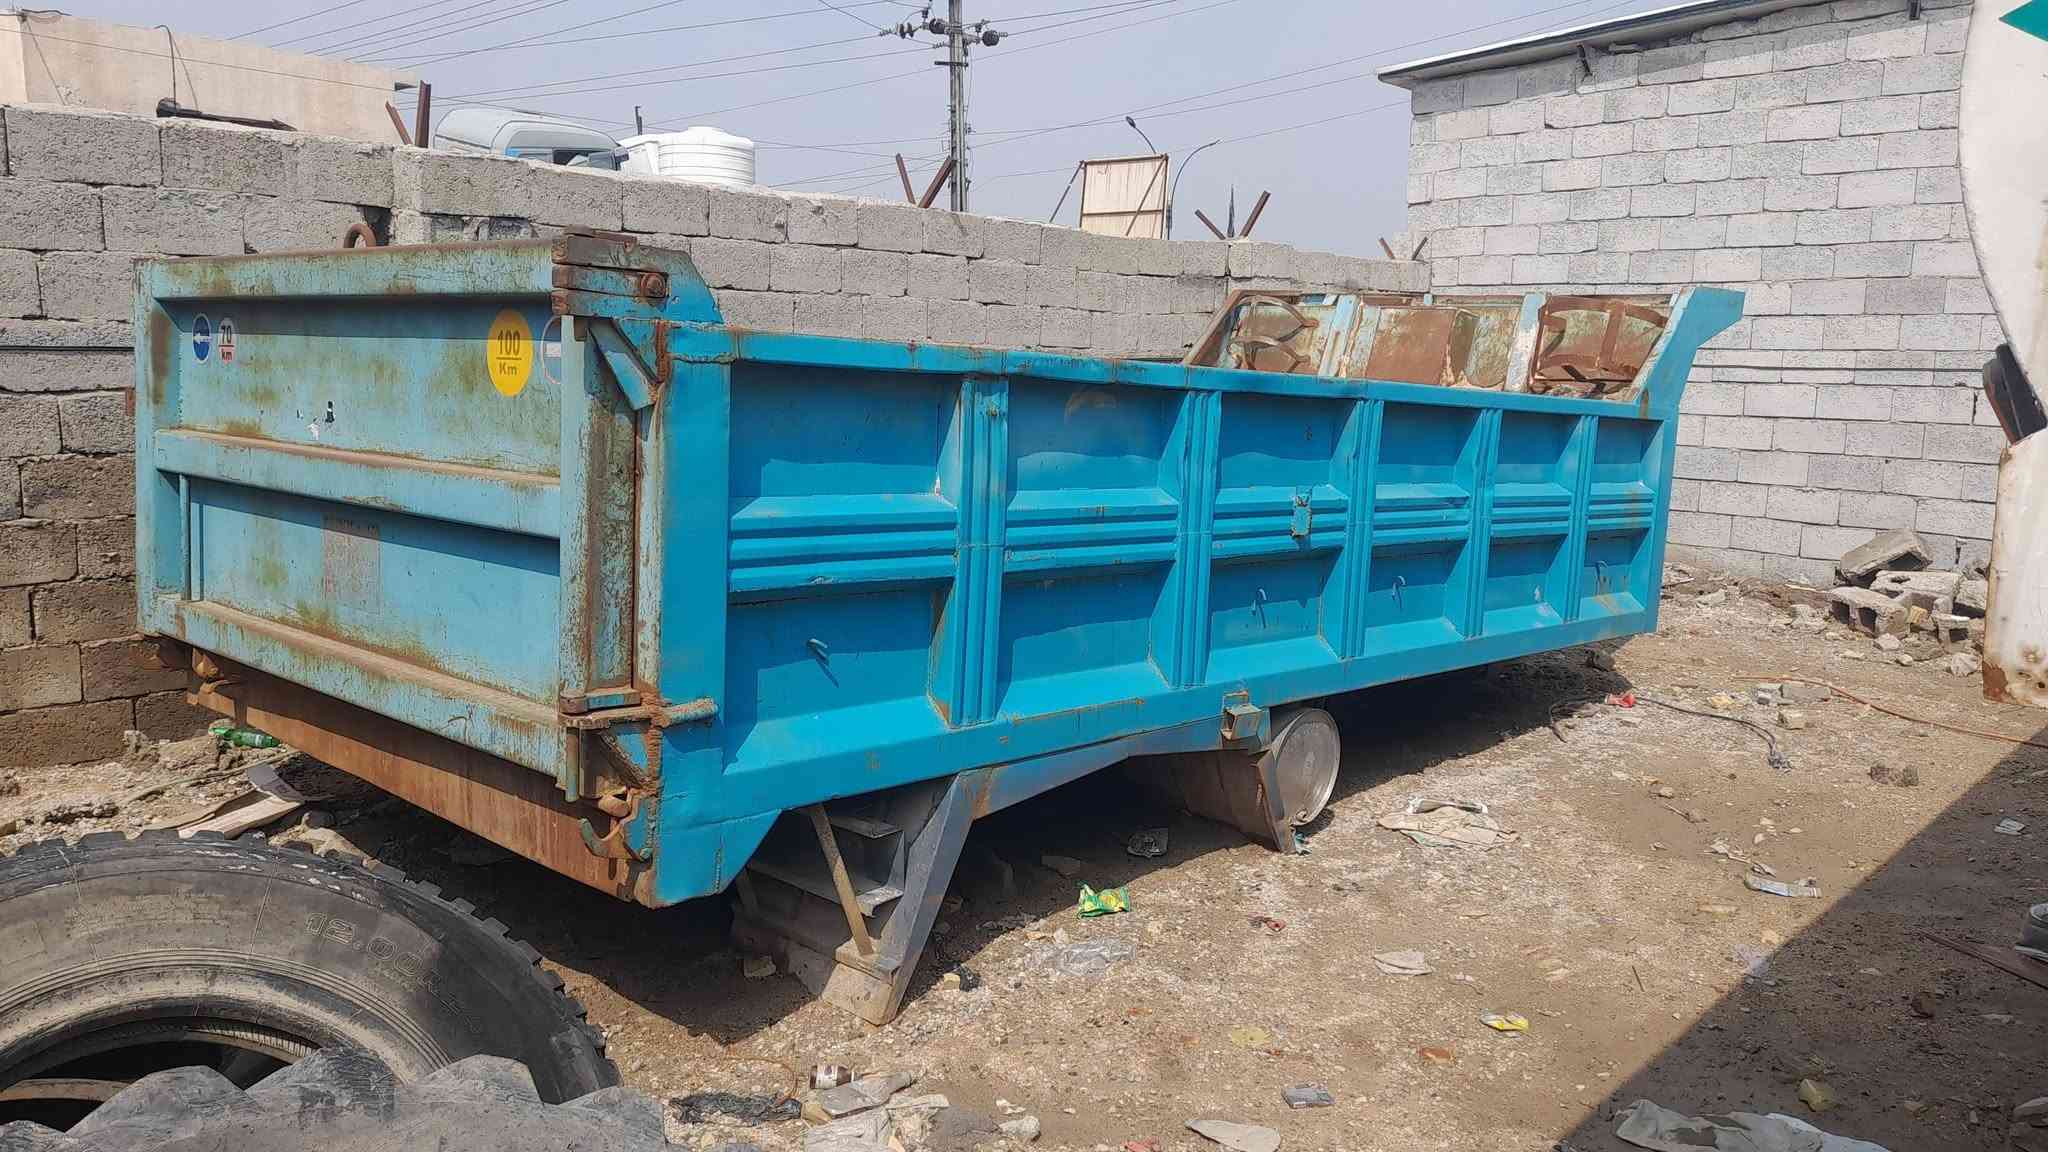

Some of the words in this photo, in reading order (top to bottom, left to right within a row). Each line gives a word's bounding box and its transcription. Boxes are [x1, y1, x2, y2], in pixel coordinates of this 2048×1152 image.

[221, 325, 232, 344] 70
[497, 329, 520, 356] 100
[499, 362, 517, 376] Km
